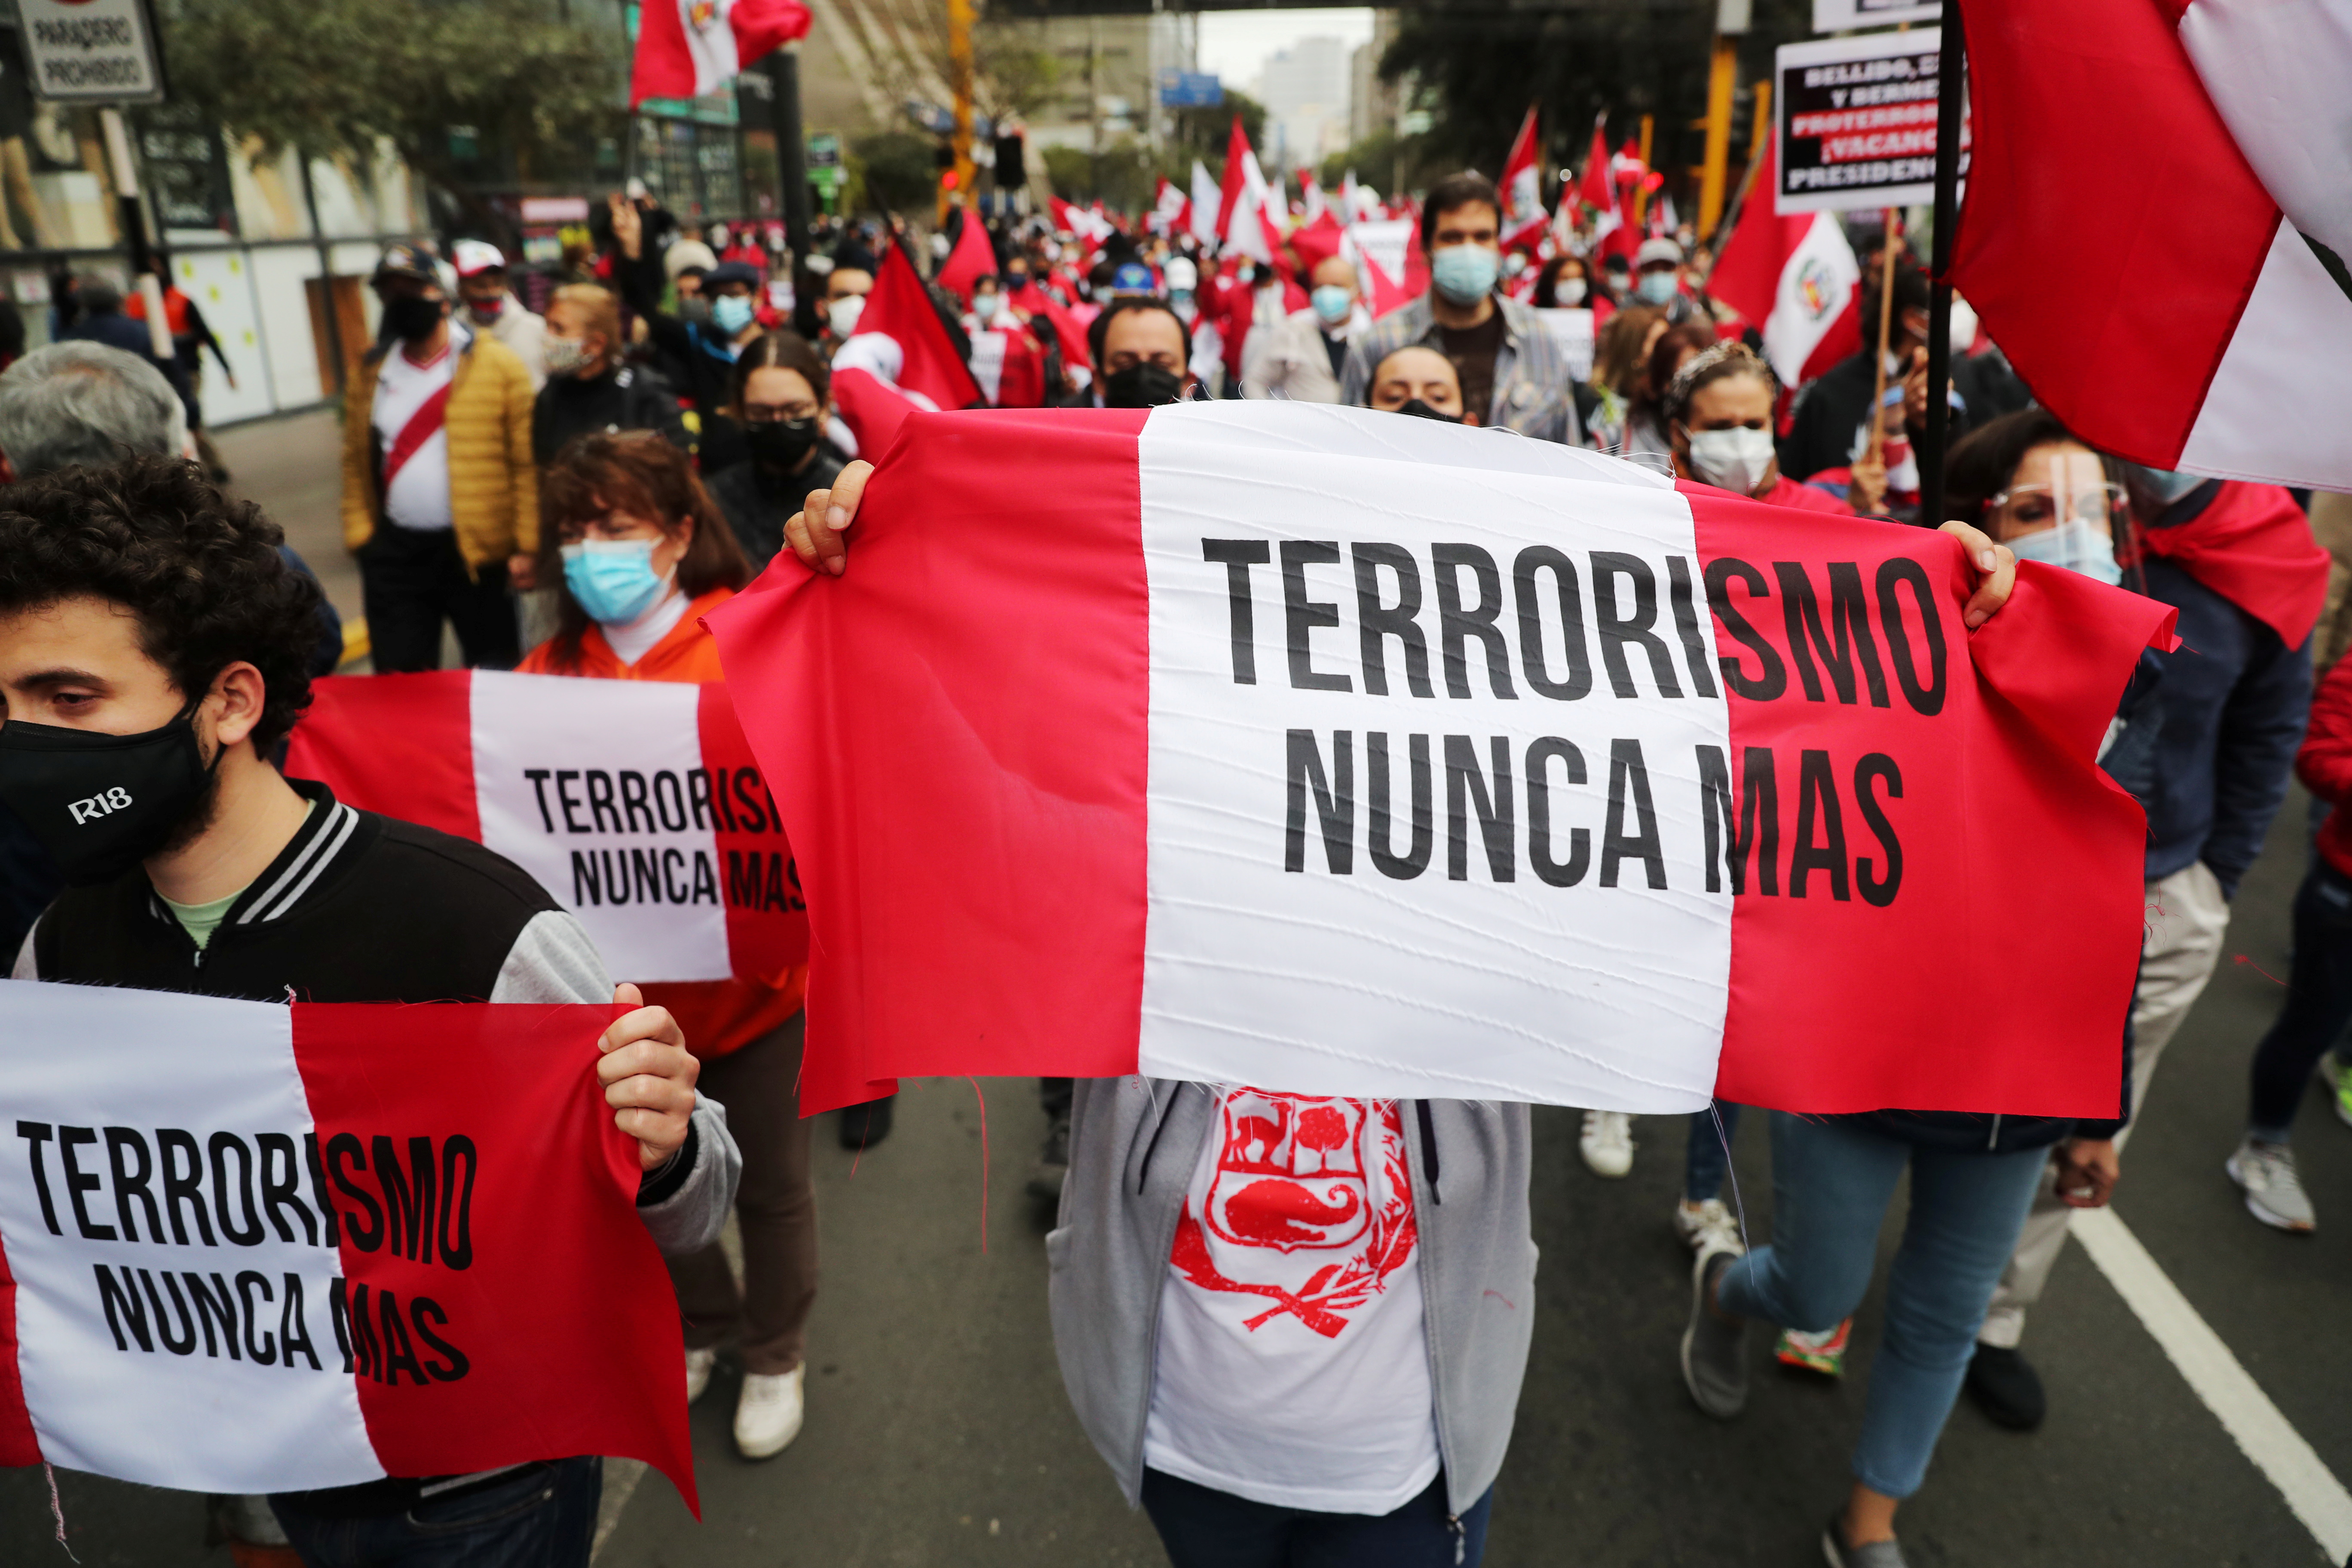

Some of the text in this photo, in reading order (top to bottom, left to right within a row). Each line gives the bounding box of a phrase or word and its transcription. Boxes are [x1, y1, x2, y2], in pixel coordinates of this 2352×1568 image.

[1850, 79, 1939, 107] BERME
[1792, 103, 1938, 138] PROTERROR
[1821, 129, 1937, 164] ¡VACANC
[1788, 156, 1936, 190] PRESIDEN
[1201, 537, 1947, 717] TERRORISMO
[67, 787, 133, 825] R18
[1284, 728, 1904, 908] NUNCA MAS
[571, 848, 806, 913] NUNCA MAS
[16, 1120, 478, 1271] TERRORISMO
[93, 1264, 471, 1387] NUNCA MAS
